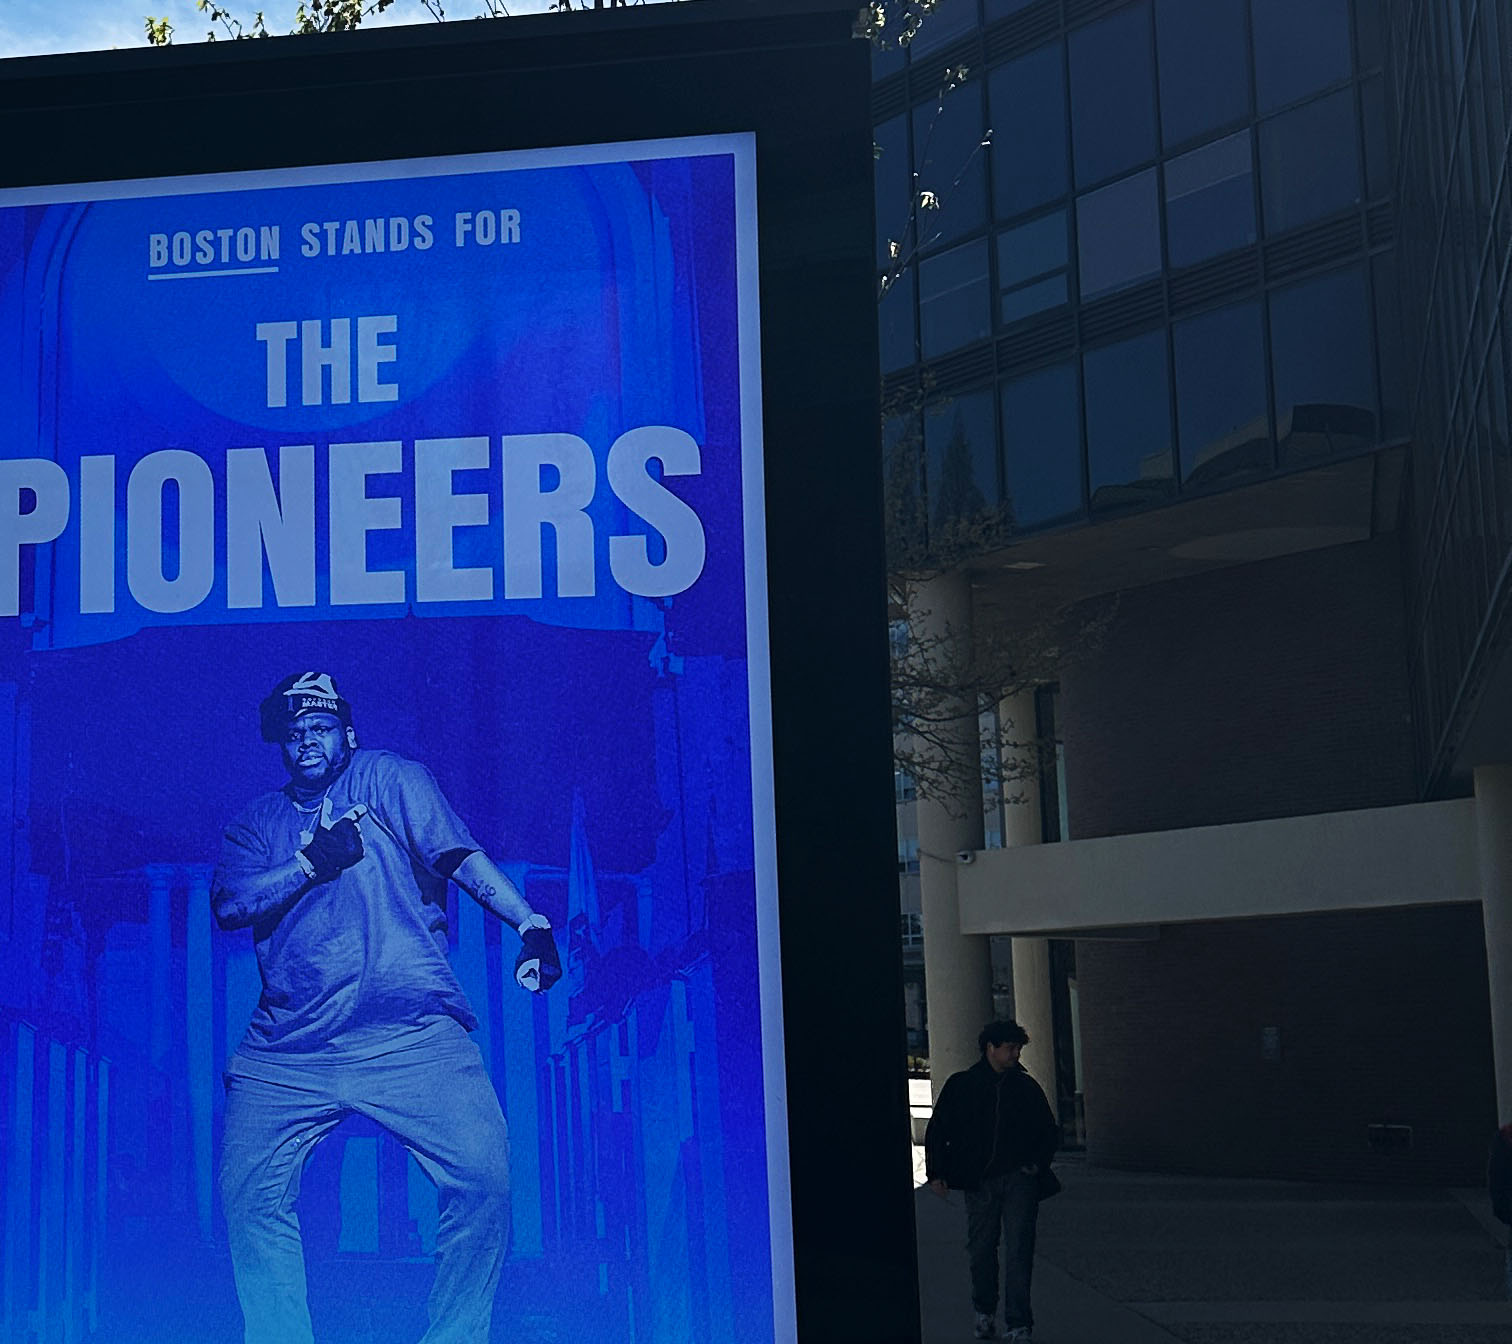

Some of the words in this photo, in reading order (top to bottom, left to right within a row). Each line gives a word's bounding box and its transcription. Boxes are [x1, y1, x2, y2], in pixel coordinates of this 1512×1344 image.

[149, 225, 280, 268] BOSTON
[301, 214, 434, 258] STANDS
[455, 208, 521, 247] FOR
[255, 314, 399, 408] THE
